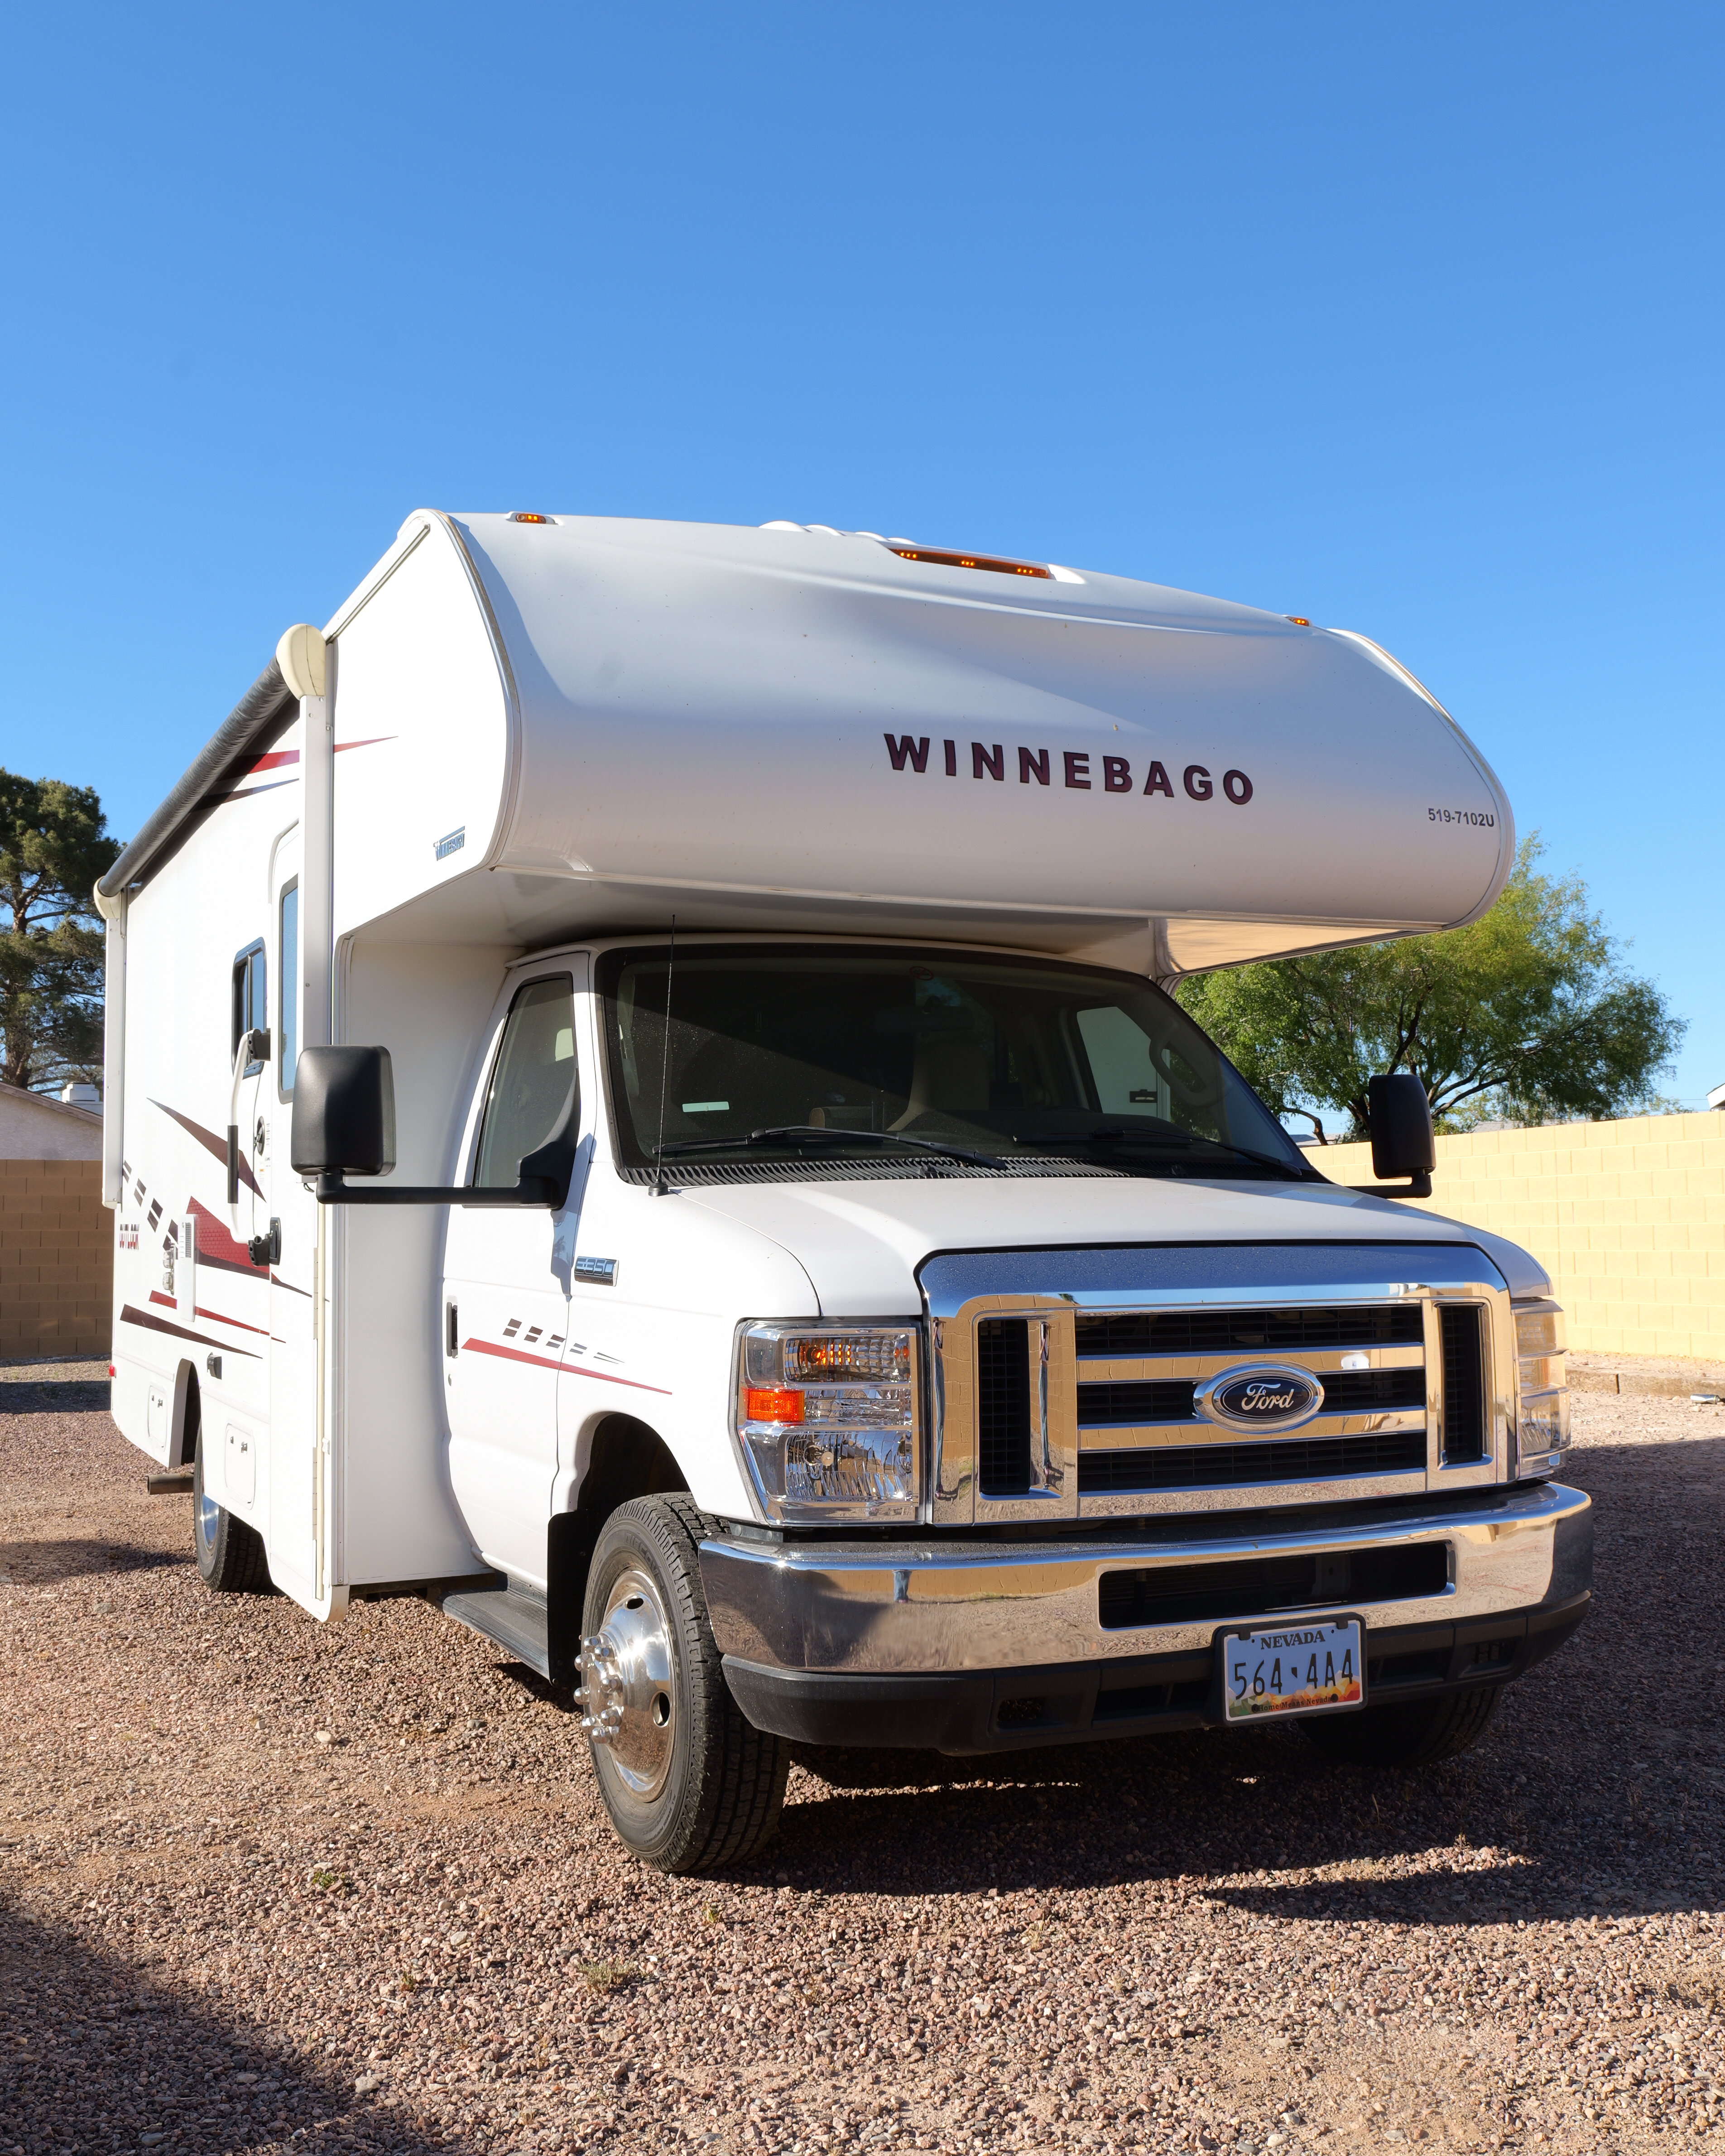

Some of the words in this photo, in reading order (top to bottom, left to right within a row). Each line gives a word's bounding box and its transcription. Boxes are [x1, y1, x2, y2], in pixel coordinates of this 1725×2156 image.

[883, 733, 1254, 805] WINNEBAGO
[1428, 807, 1494, 827] 519-7102U
[1241, 1383, 1294, 1411] Ford
[1260, 1630, 1326, 1650] NEVADA
[1234, 1657, 1283, 1700] 564
[1306, 1648, 1353, 1689] 4A4
